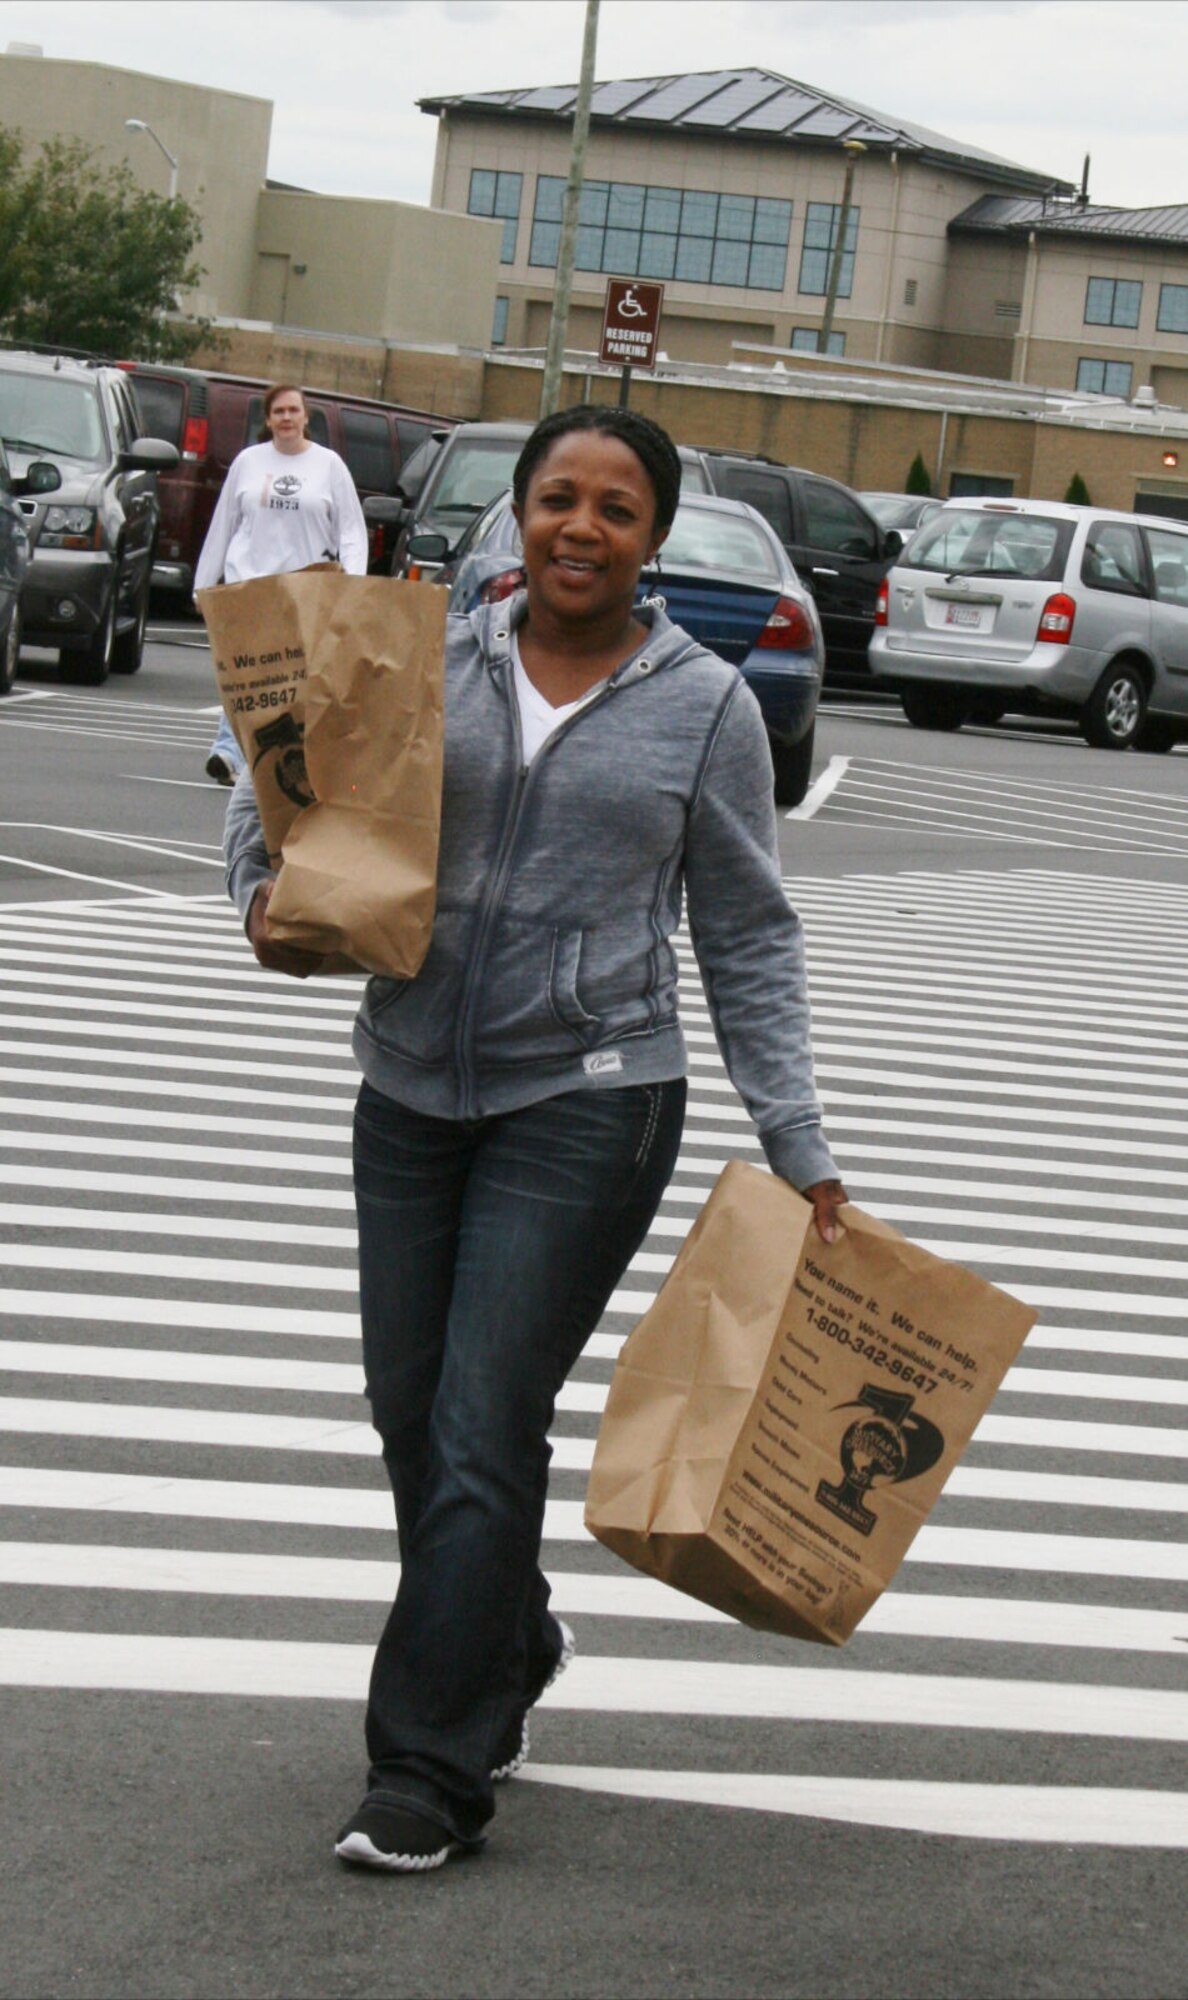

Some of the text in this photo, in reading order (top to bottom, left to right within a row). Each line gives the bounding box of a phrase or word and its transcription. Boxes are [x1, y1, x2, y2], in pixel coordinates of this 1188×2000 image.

[606, 327, 652, 344] RESERVED
[607, 341, 648, 357] PARKING
[233, 653, 256, 669] We
[260, 651, 282, 664] can
[249, 672, 289, 689] available
[805, 1258, 977, 1372] You name it. We can help.
[814, 1295, 826, 1307] to
[827, 1303, 853, 1323] talk?
[858, 1320, 889, 1345] We're
[890, 1342, 936, 1372] available
[807, 1308, 938, 1394] 1-800-342-9647
